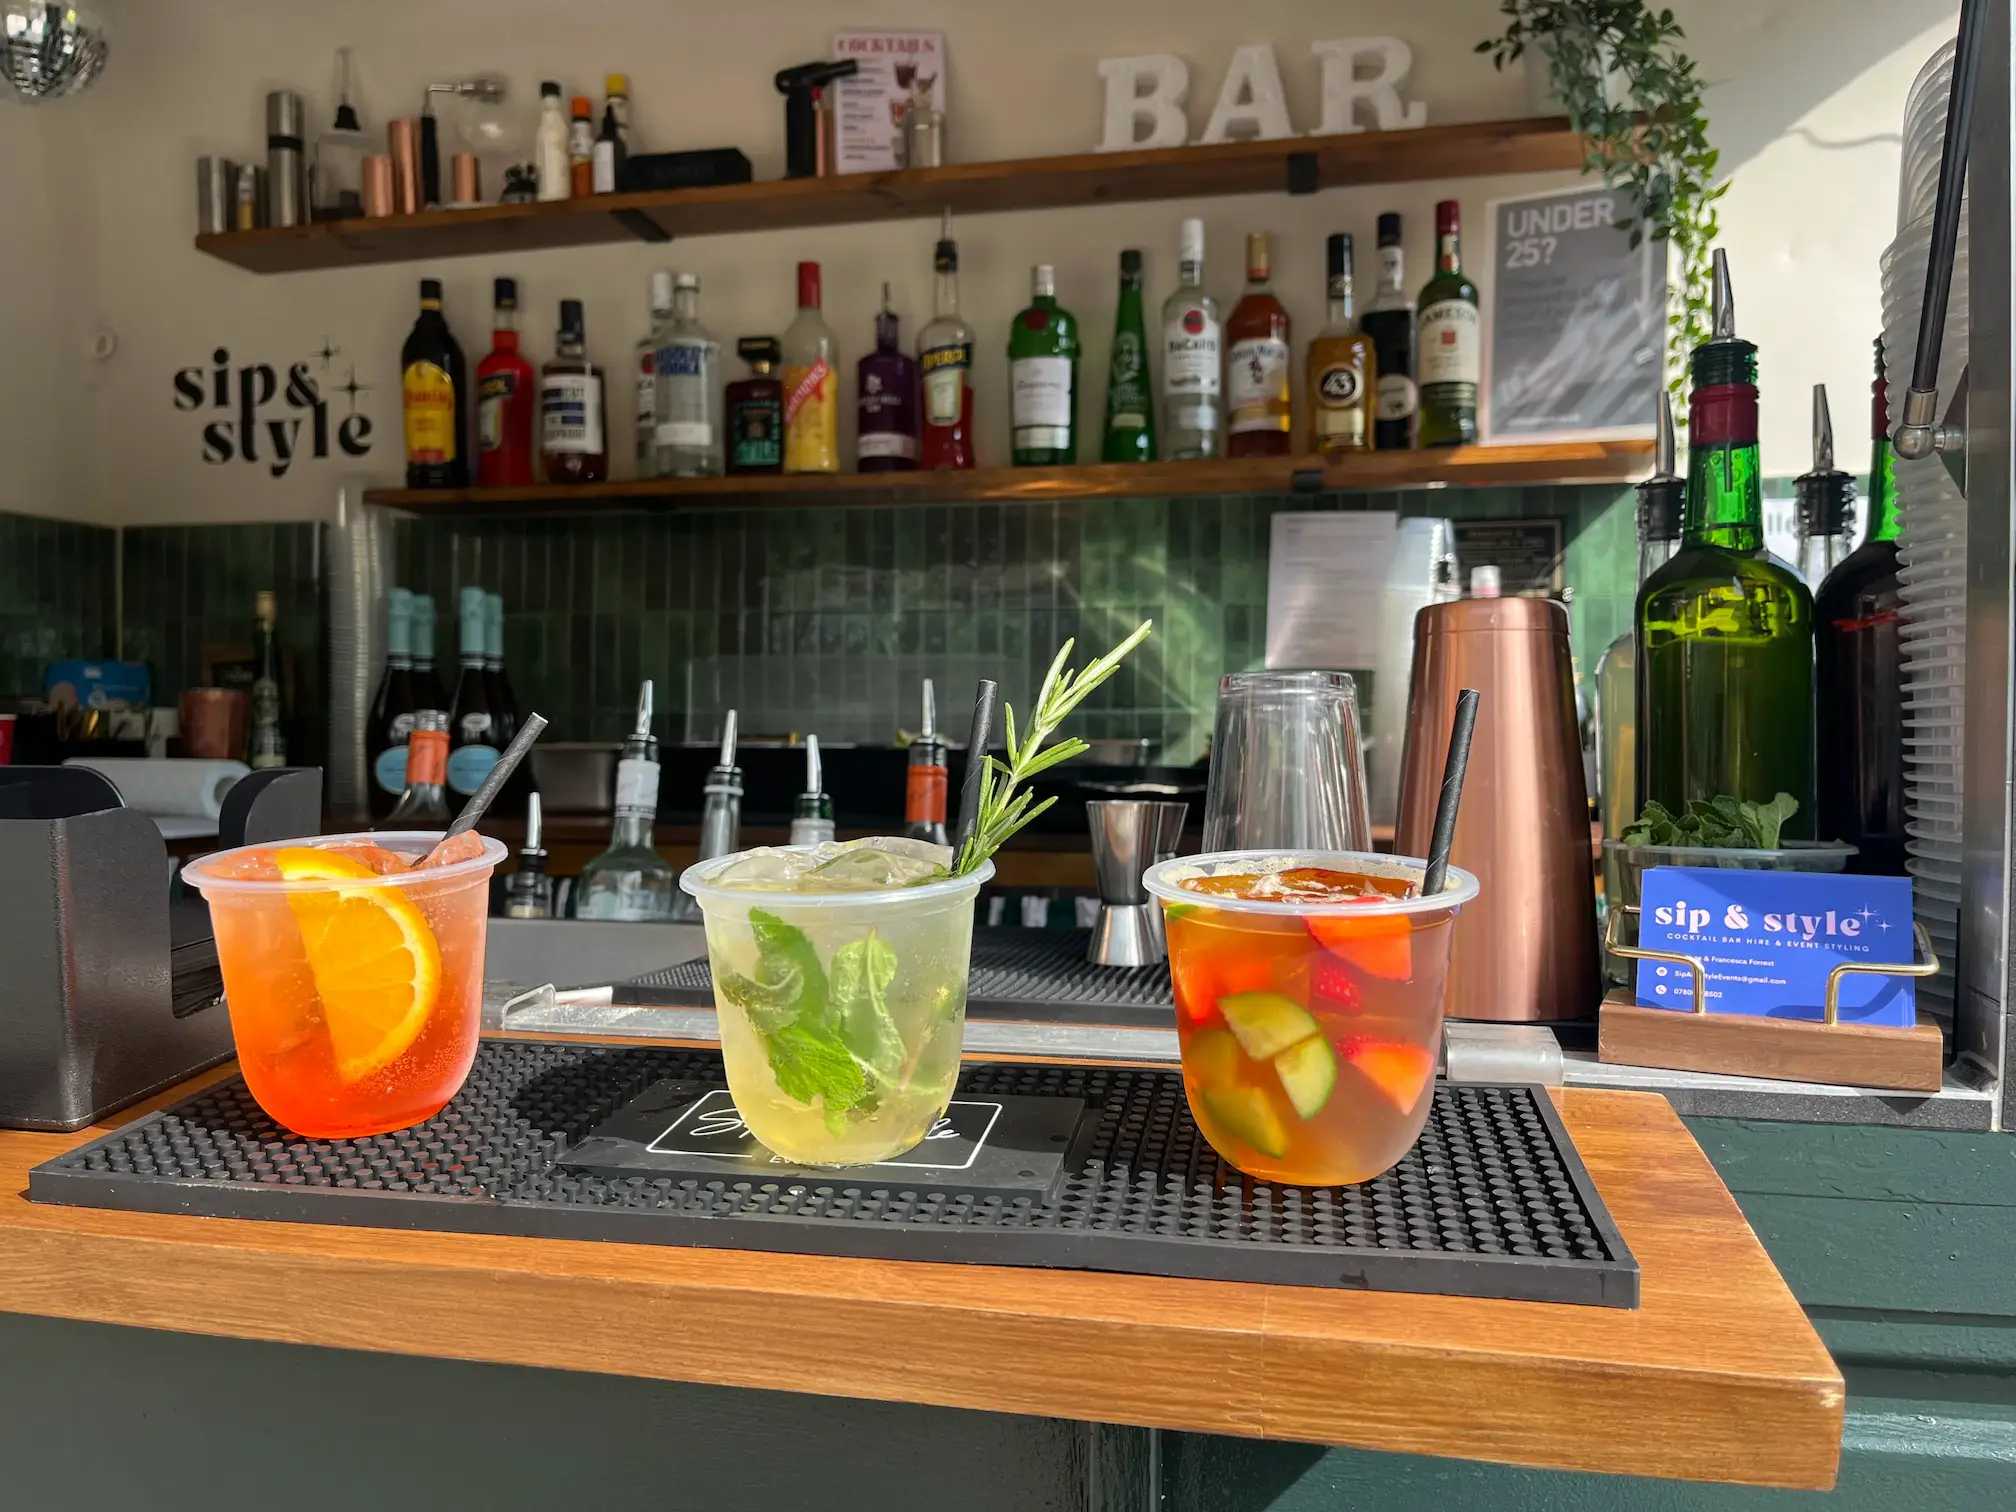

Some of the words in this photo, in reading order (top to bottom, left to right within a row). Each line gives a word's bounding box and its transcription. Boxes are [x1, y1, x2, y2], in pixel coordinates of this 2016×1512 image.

[1095, 35, 1428, 153] BAR
[1507, 199, 1615, 238] UNDER
[1505, 237, 1557, 269] 25?
[202, 401, 373, 479] style
[1654, 900, 1711, 934] sip
[1724, 903, 1750, 931] &
[1762, 910, 1862, 941] style
[1666, 932, 1718, 943] COCKTAIL
[1722, 936, 1742, 944] BAR
[1746, 938, 1771, 946] HIRE
[1775, 939, 1782, 947] &
[1787, 940, 1820, 949] EVENT
[1824, 942, 1870, 953] STYLING
[1673, 969, 1787, 984] SipAtyleEvents@gmail.com
[1703, 955, 1710, 963] &
[1711, 955, 1748, 966] Francesca
[1749, 958, 1775, 968] Forrest
